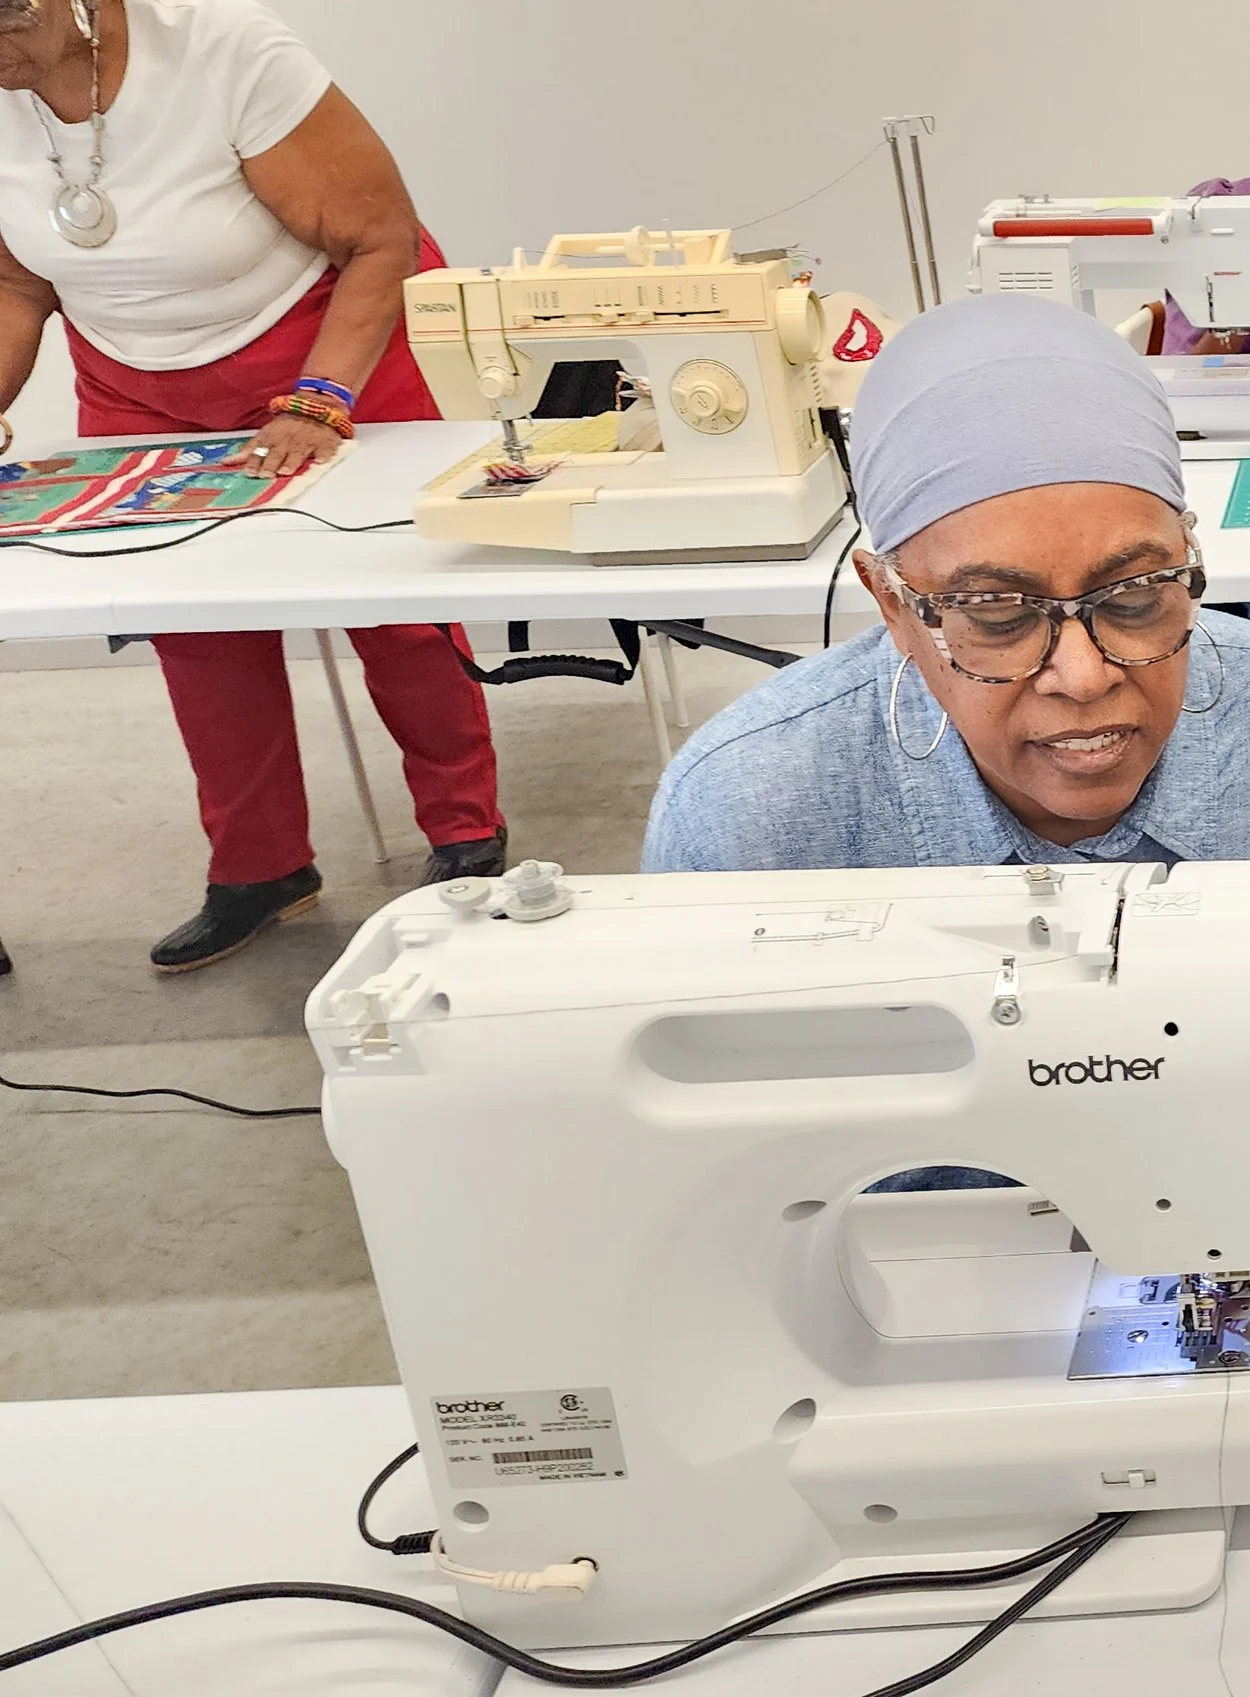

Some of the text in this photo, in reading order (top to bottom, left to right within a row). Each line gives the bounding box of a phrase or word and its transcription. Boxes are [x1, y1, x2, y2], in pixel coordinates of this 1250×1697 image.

[1028, 1054, 1165, 1087] brother
[435, 1400, 505, 1414] brother
[440, 1415, 477, 1424] MODEL
